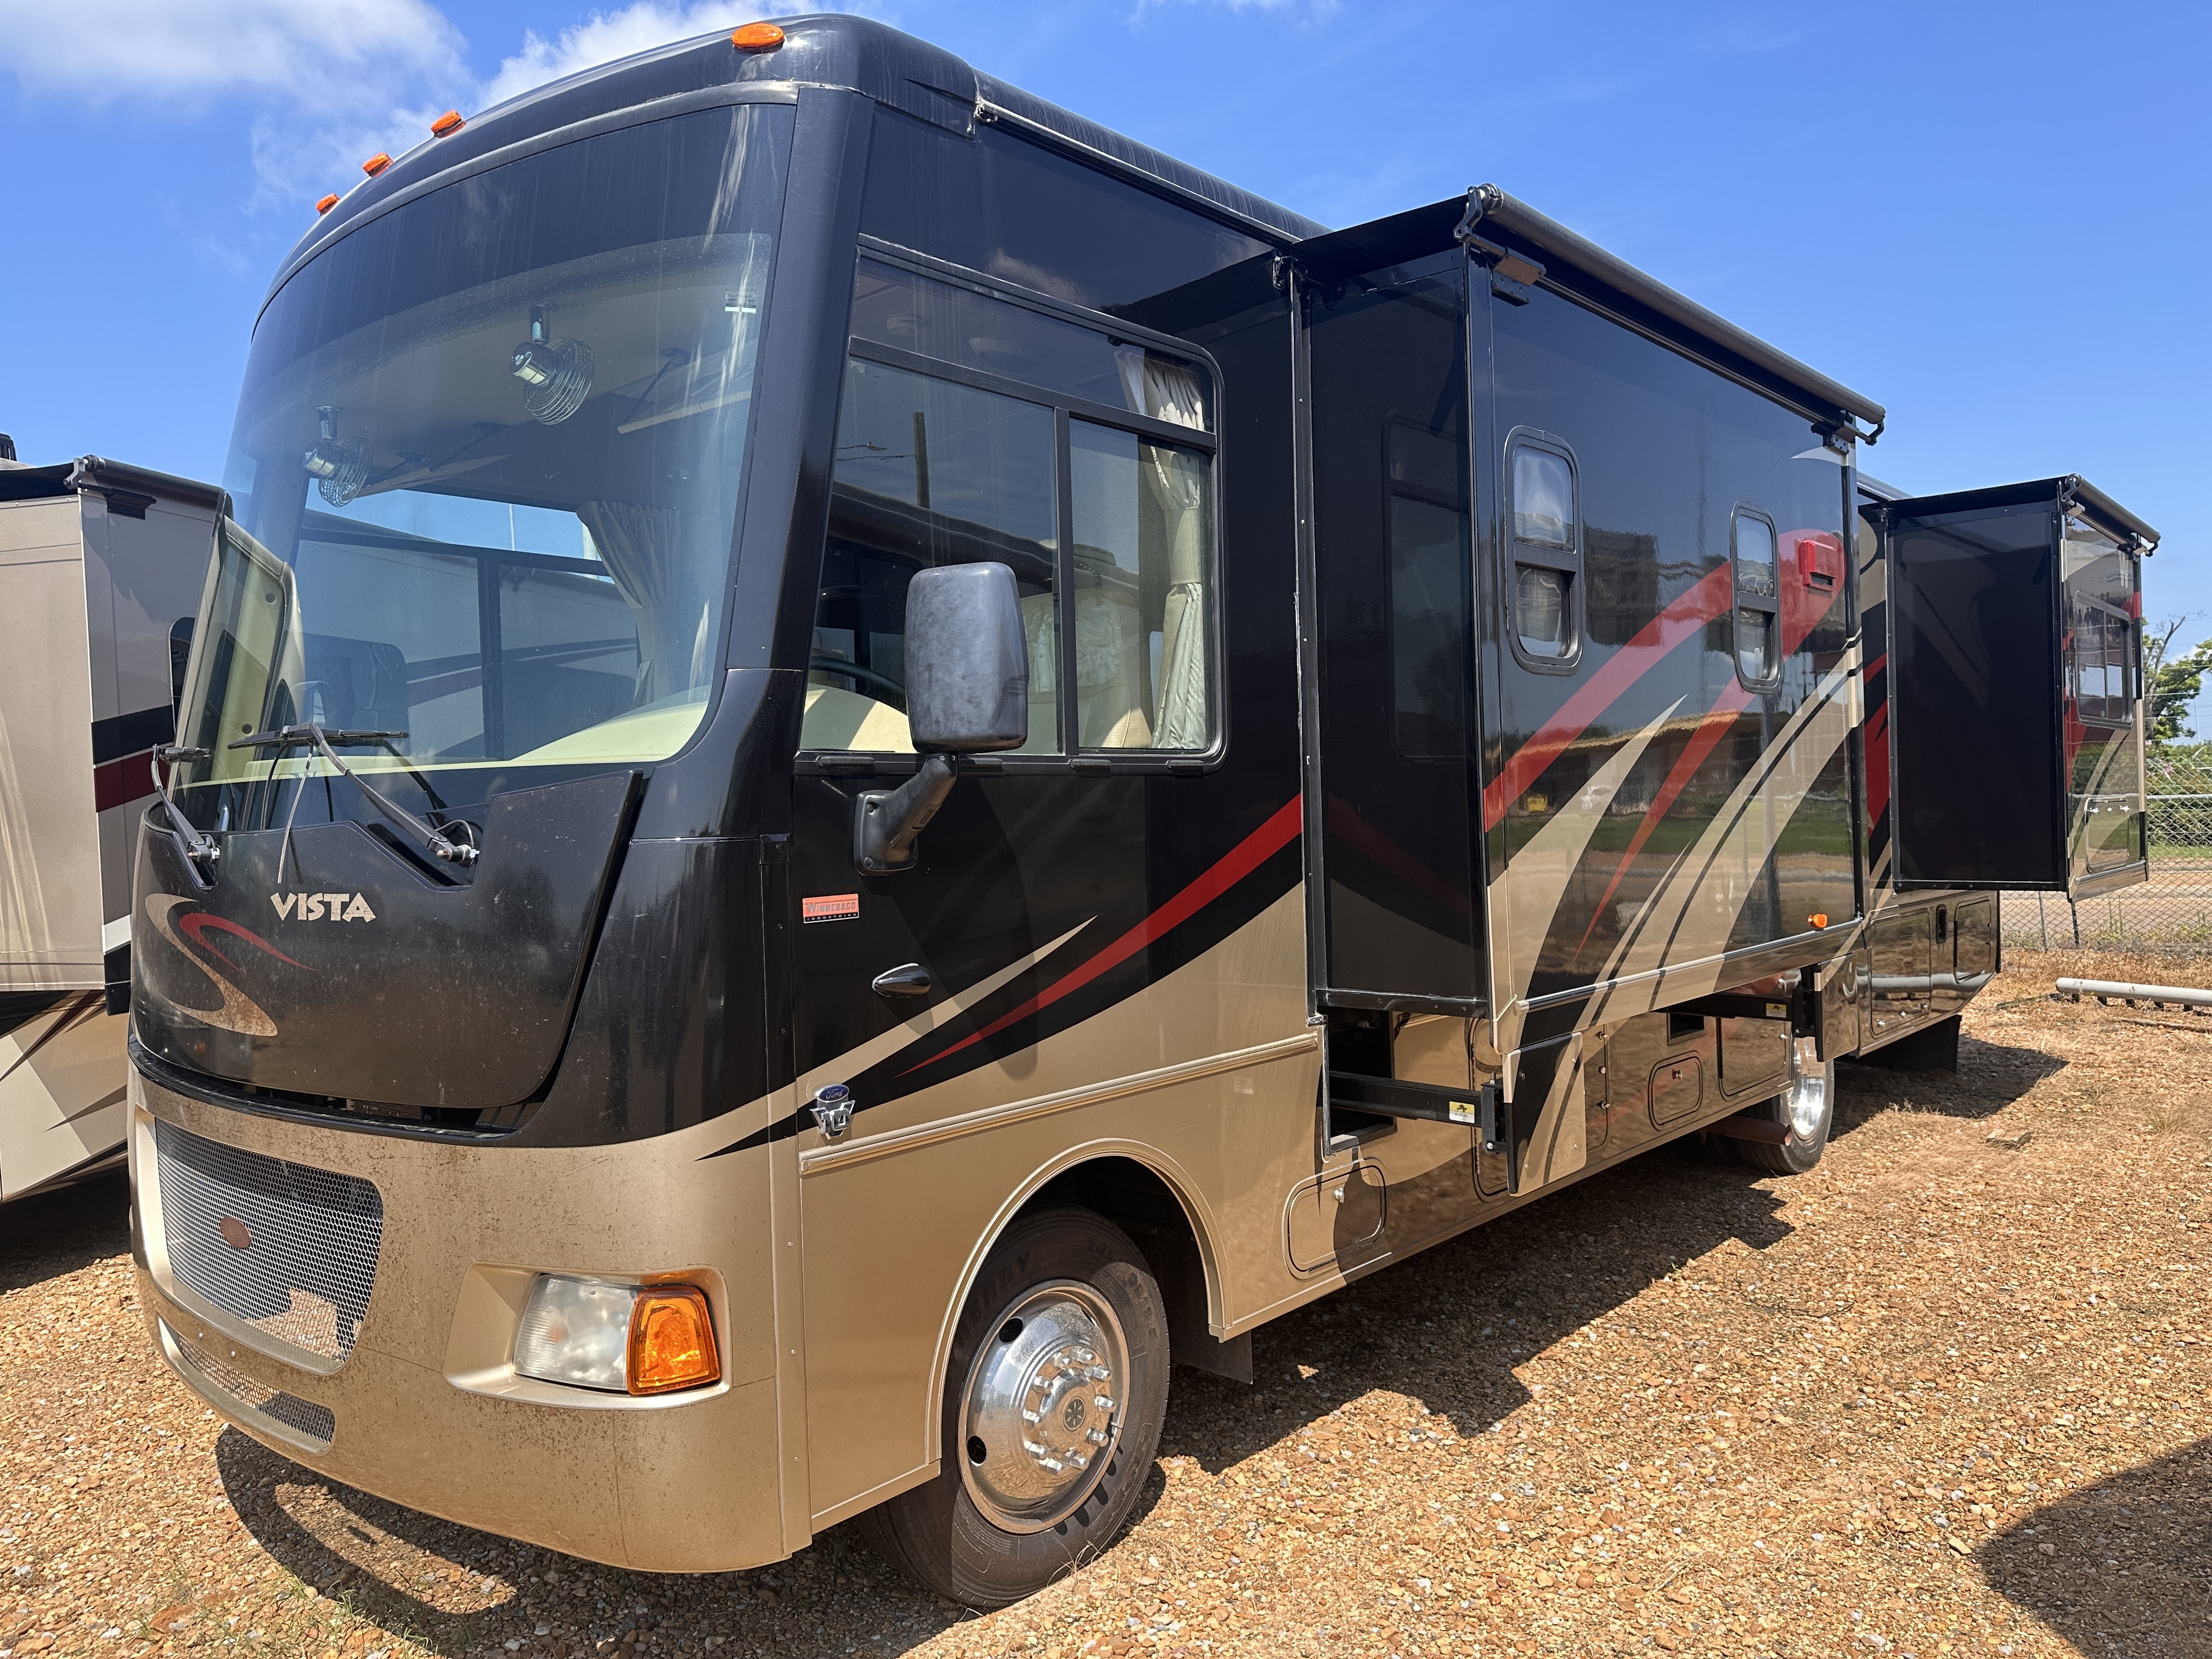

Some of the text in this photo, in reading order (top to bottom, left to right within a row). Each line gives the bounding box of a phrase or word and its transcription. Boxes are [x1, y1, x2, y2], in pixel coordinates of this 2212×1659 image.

[270, 892, 376, 922] VISTA
[804, 902, 856, 914] WINNEBAGO
[826, 1088, 843, 1099] Ford
